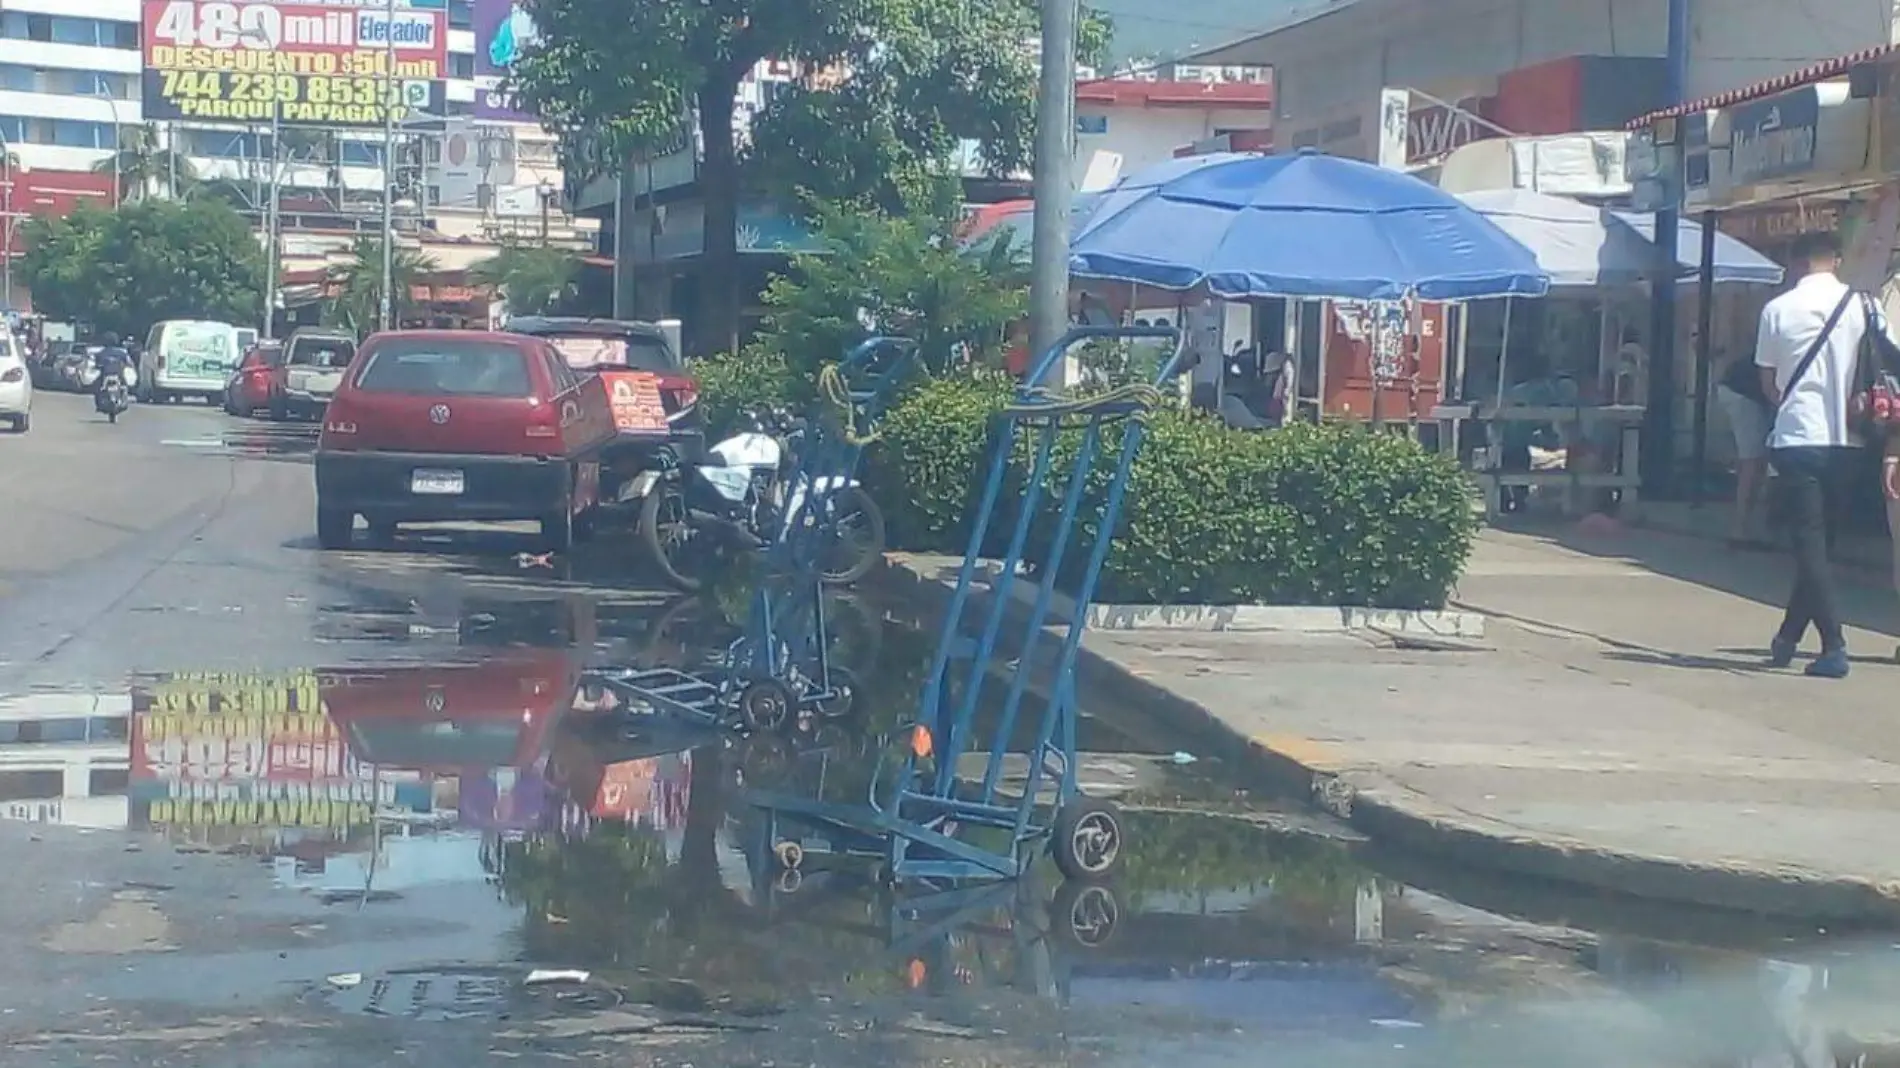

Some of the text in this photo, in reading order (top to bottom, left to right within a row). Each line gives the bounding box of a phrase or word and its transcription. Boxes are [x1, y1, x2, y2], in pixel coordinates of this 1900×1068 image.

[155, 2, 353, 50] 489 mil
[152, 45, 336, 74] DESCUENTO
[160, 70, 400, 105] 744 239 8535
